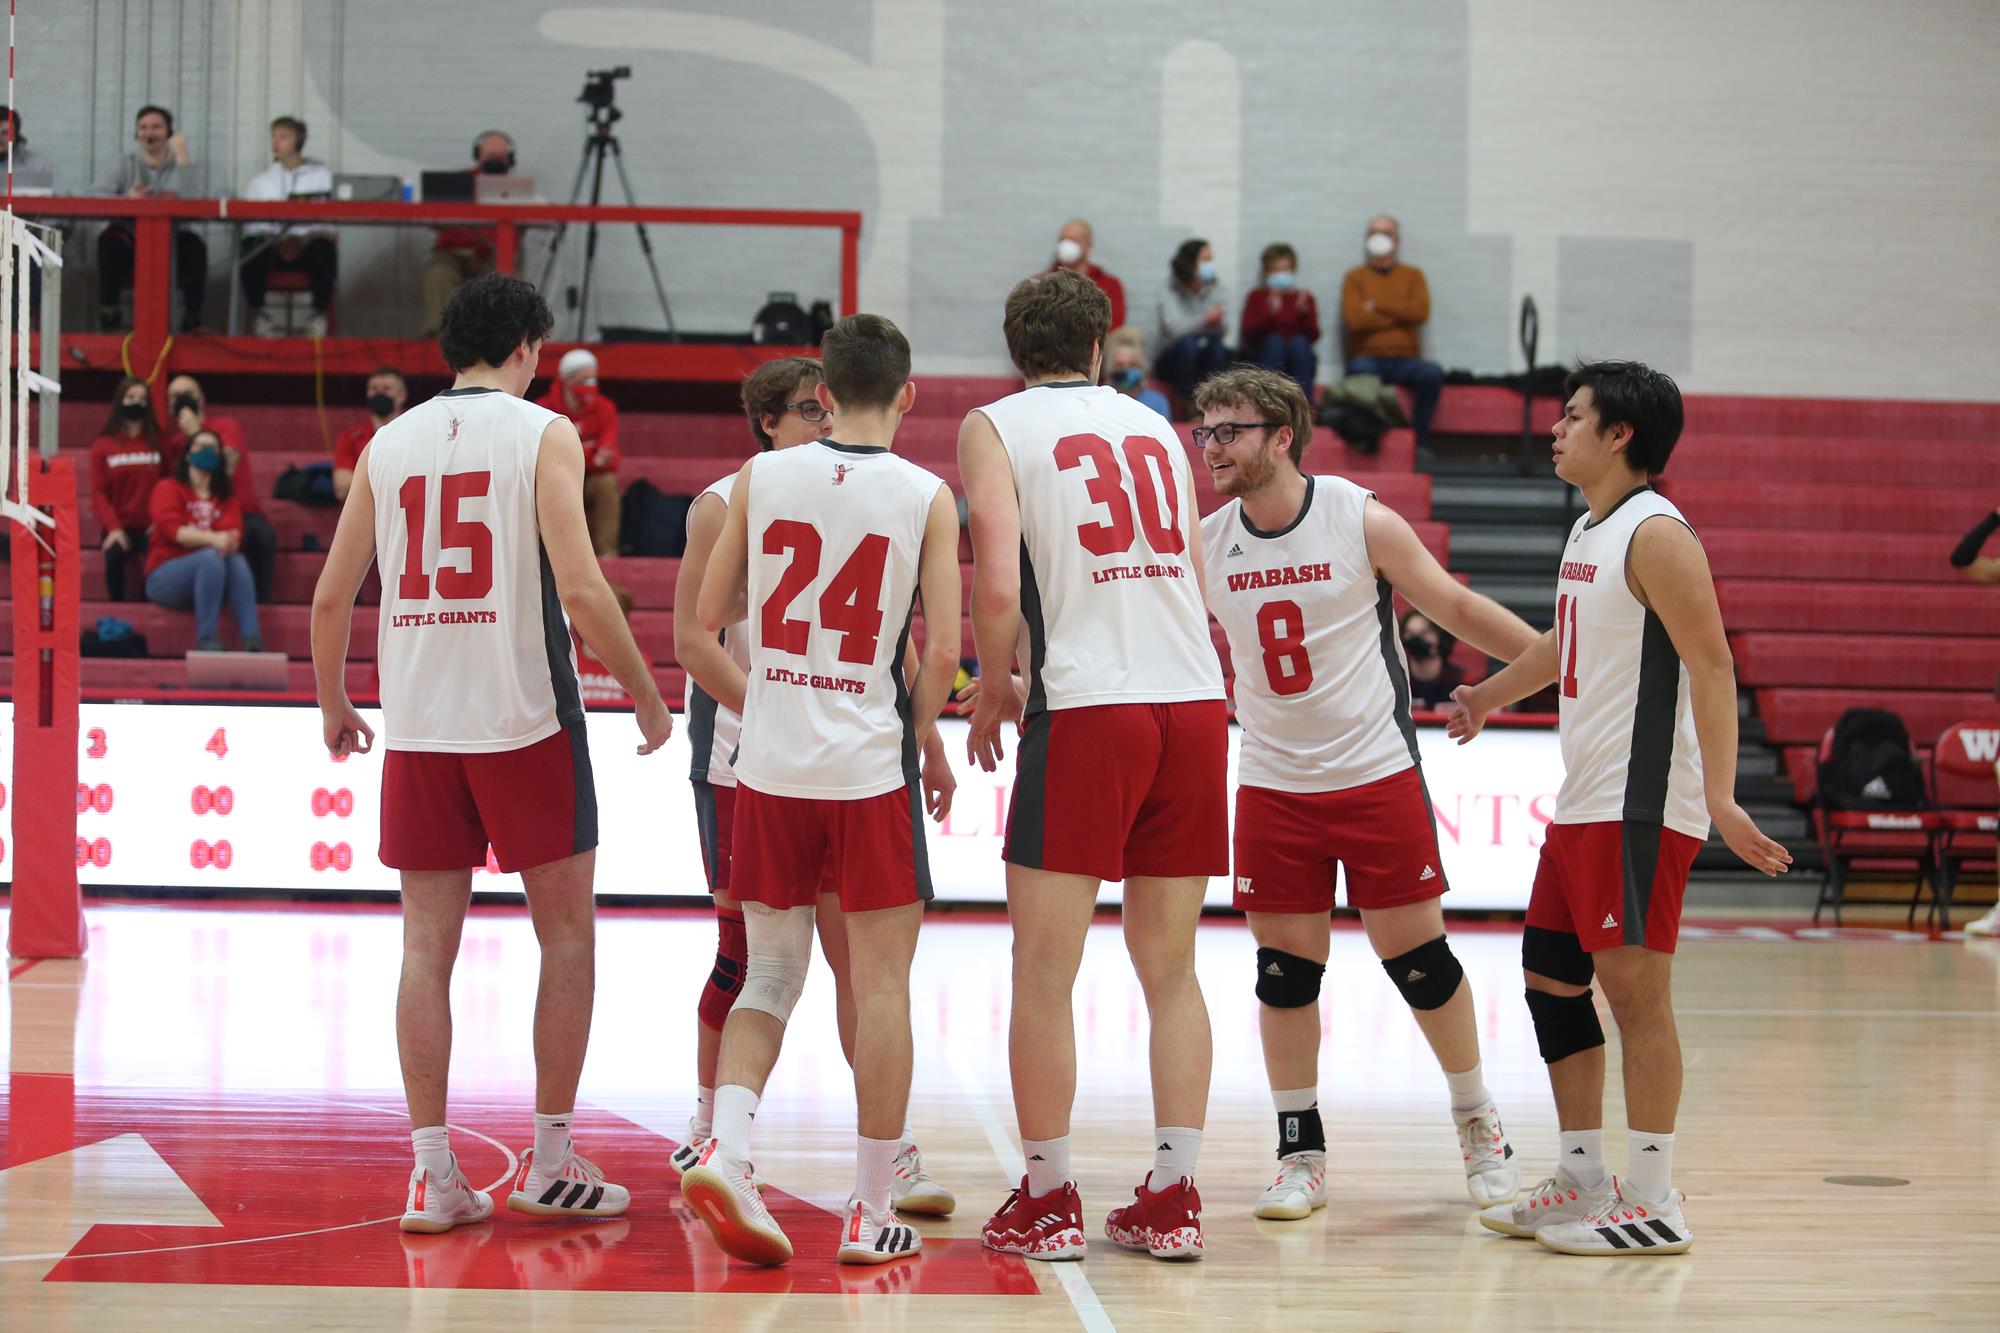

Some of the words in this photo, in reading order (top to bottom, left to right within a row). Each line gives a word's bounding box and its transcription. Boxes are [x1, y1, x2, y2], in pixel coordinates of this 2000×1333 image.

[1052, 433, 1186, 556] 30
[399, 470, 493, 599] 15
[1092, 566, 1142, 584] LITTLE
[1144, 564, 1185, 578] GIANT
[1227, 563, 1331, 592] WABASH
[1560, 561, 1598, 583] WABASH
[761, 519, 890, 665] 24
[392, 614, 436, 628] LITTLE
[438, 611, 497, 625] GIANTS
[1256, 599, 1313, 696] 8
[1558, 594, 1577, 698] 11
[810, 675, 866, 695] GIANTS
[86, 727, 108, 759] 3
[205, 727, 228, 759] 4
[191, 785, 233, 816] 00
[311, 787, 354, 818] 00
[190, 839, 233, 870] 00
[310, 841, 353, 872] 00
